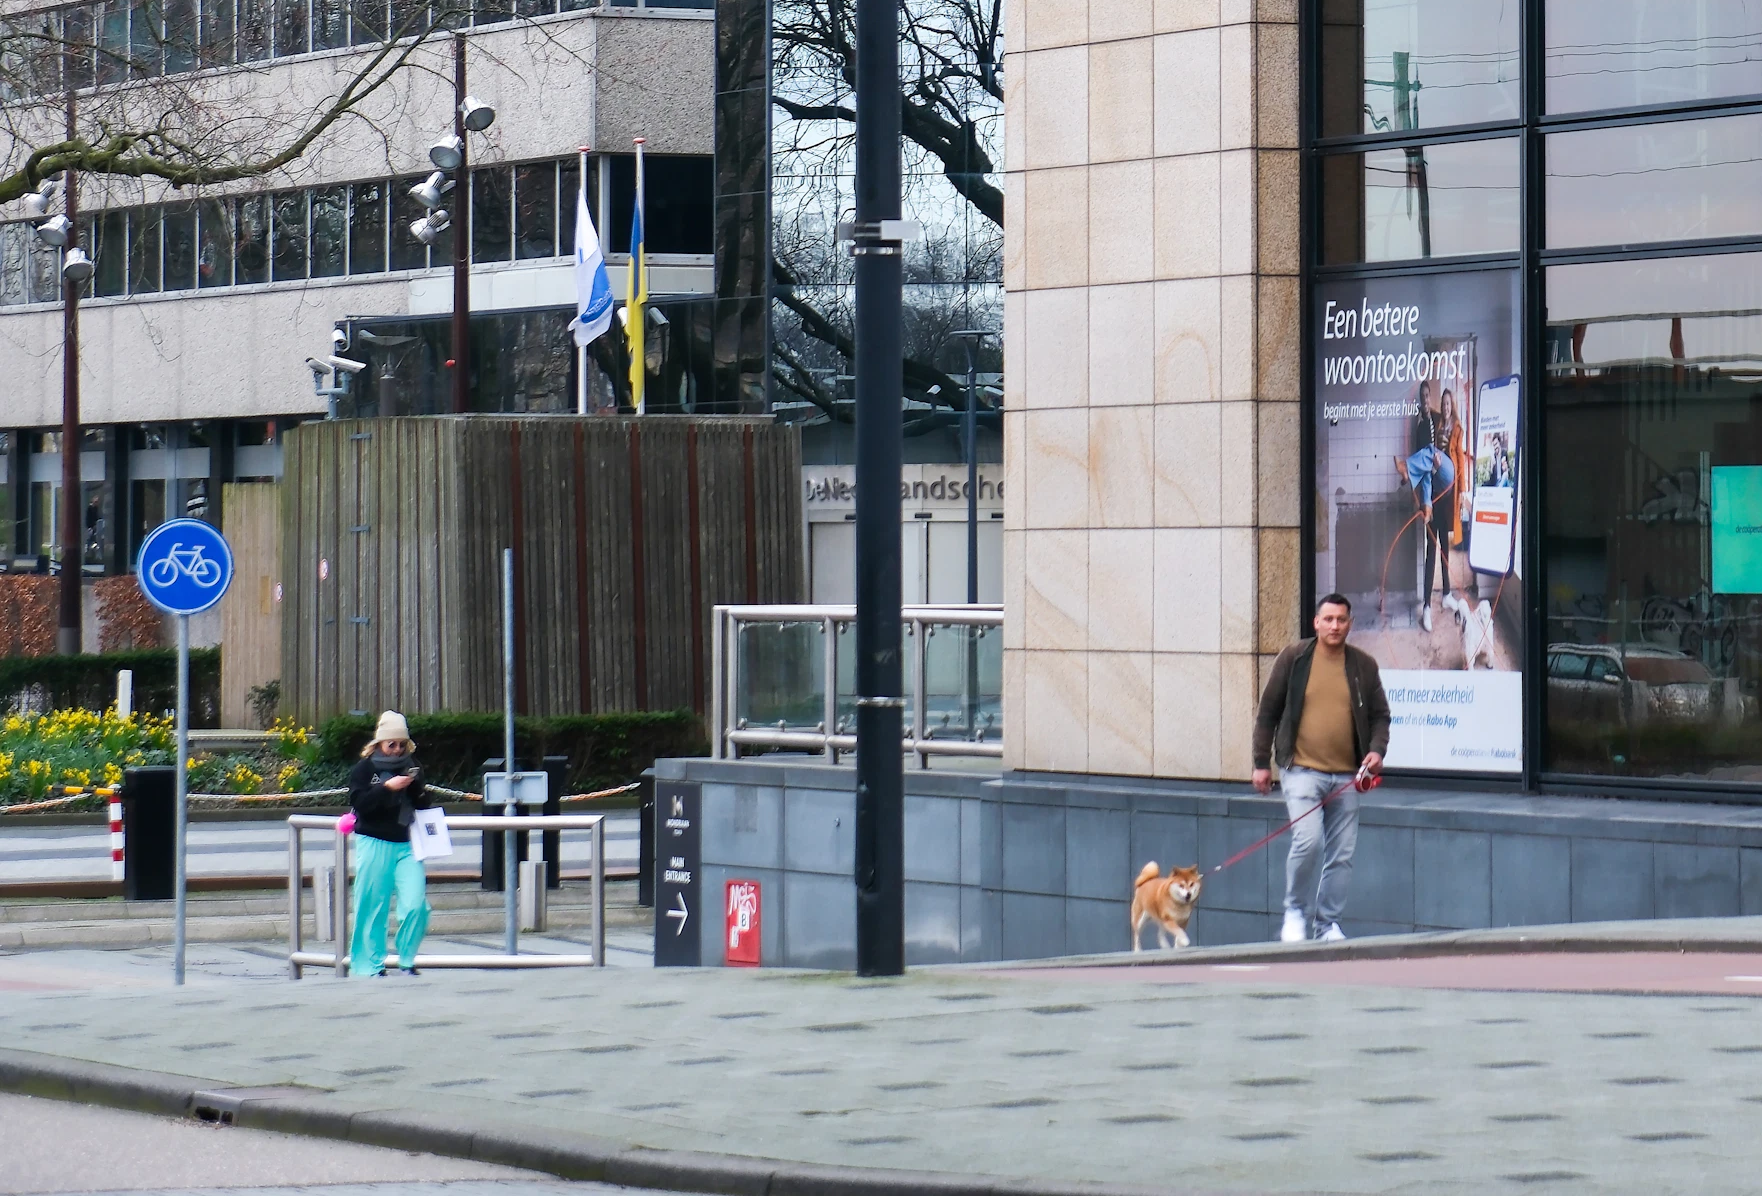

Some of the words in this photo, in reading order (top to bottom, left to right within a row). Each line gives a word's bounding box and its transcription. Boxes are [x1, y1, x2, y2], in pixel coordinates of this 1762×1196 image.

[1323, 300, 1358, 339] Een
[1360, 297, 1420, 338] betere
[1324, 341, 1466, 385] woontoekomst
[1323, 401, 1350, 423] begint
[1350, 402, 1367, 418] met
[1366, 401, 1376, 421] je
[1376, 401, 1401, 417] eerste
[1401, 398, 1420, 416] huis
[1388, 687, 1406, 703] met
[1407, 687, 1430, 703] meer
[1430, 684, 1475, 704] zekerheid
[1426, 714, 1443, 725] Rabo
[1443, 714, 1458, 729] App
[671, 856, 685, 868] MAIN
[664, 870, 691, 884] ENTRANCE
